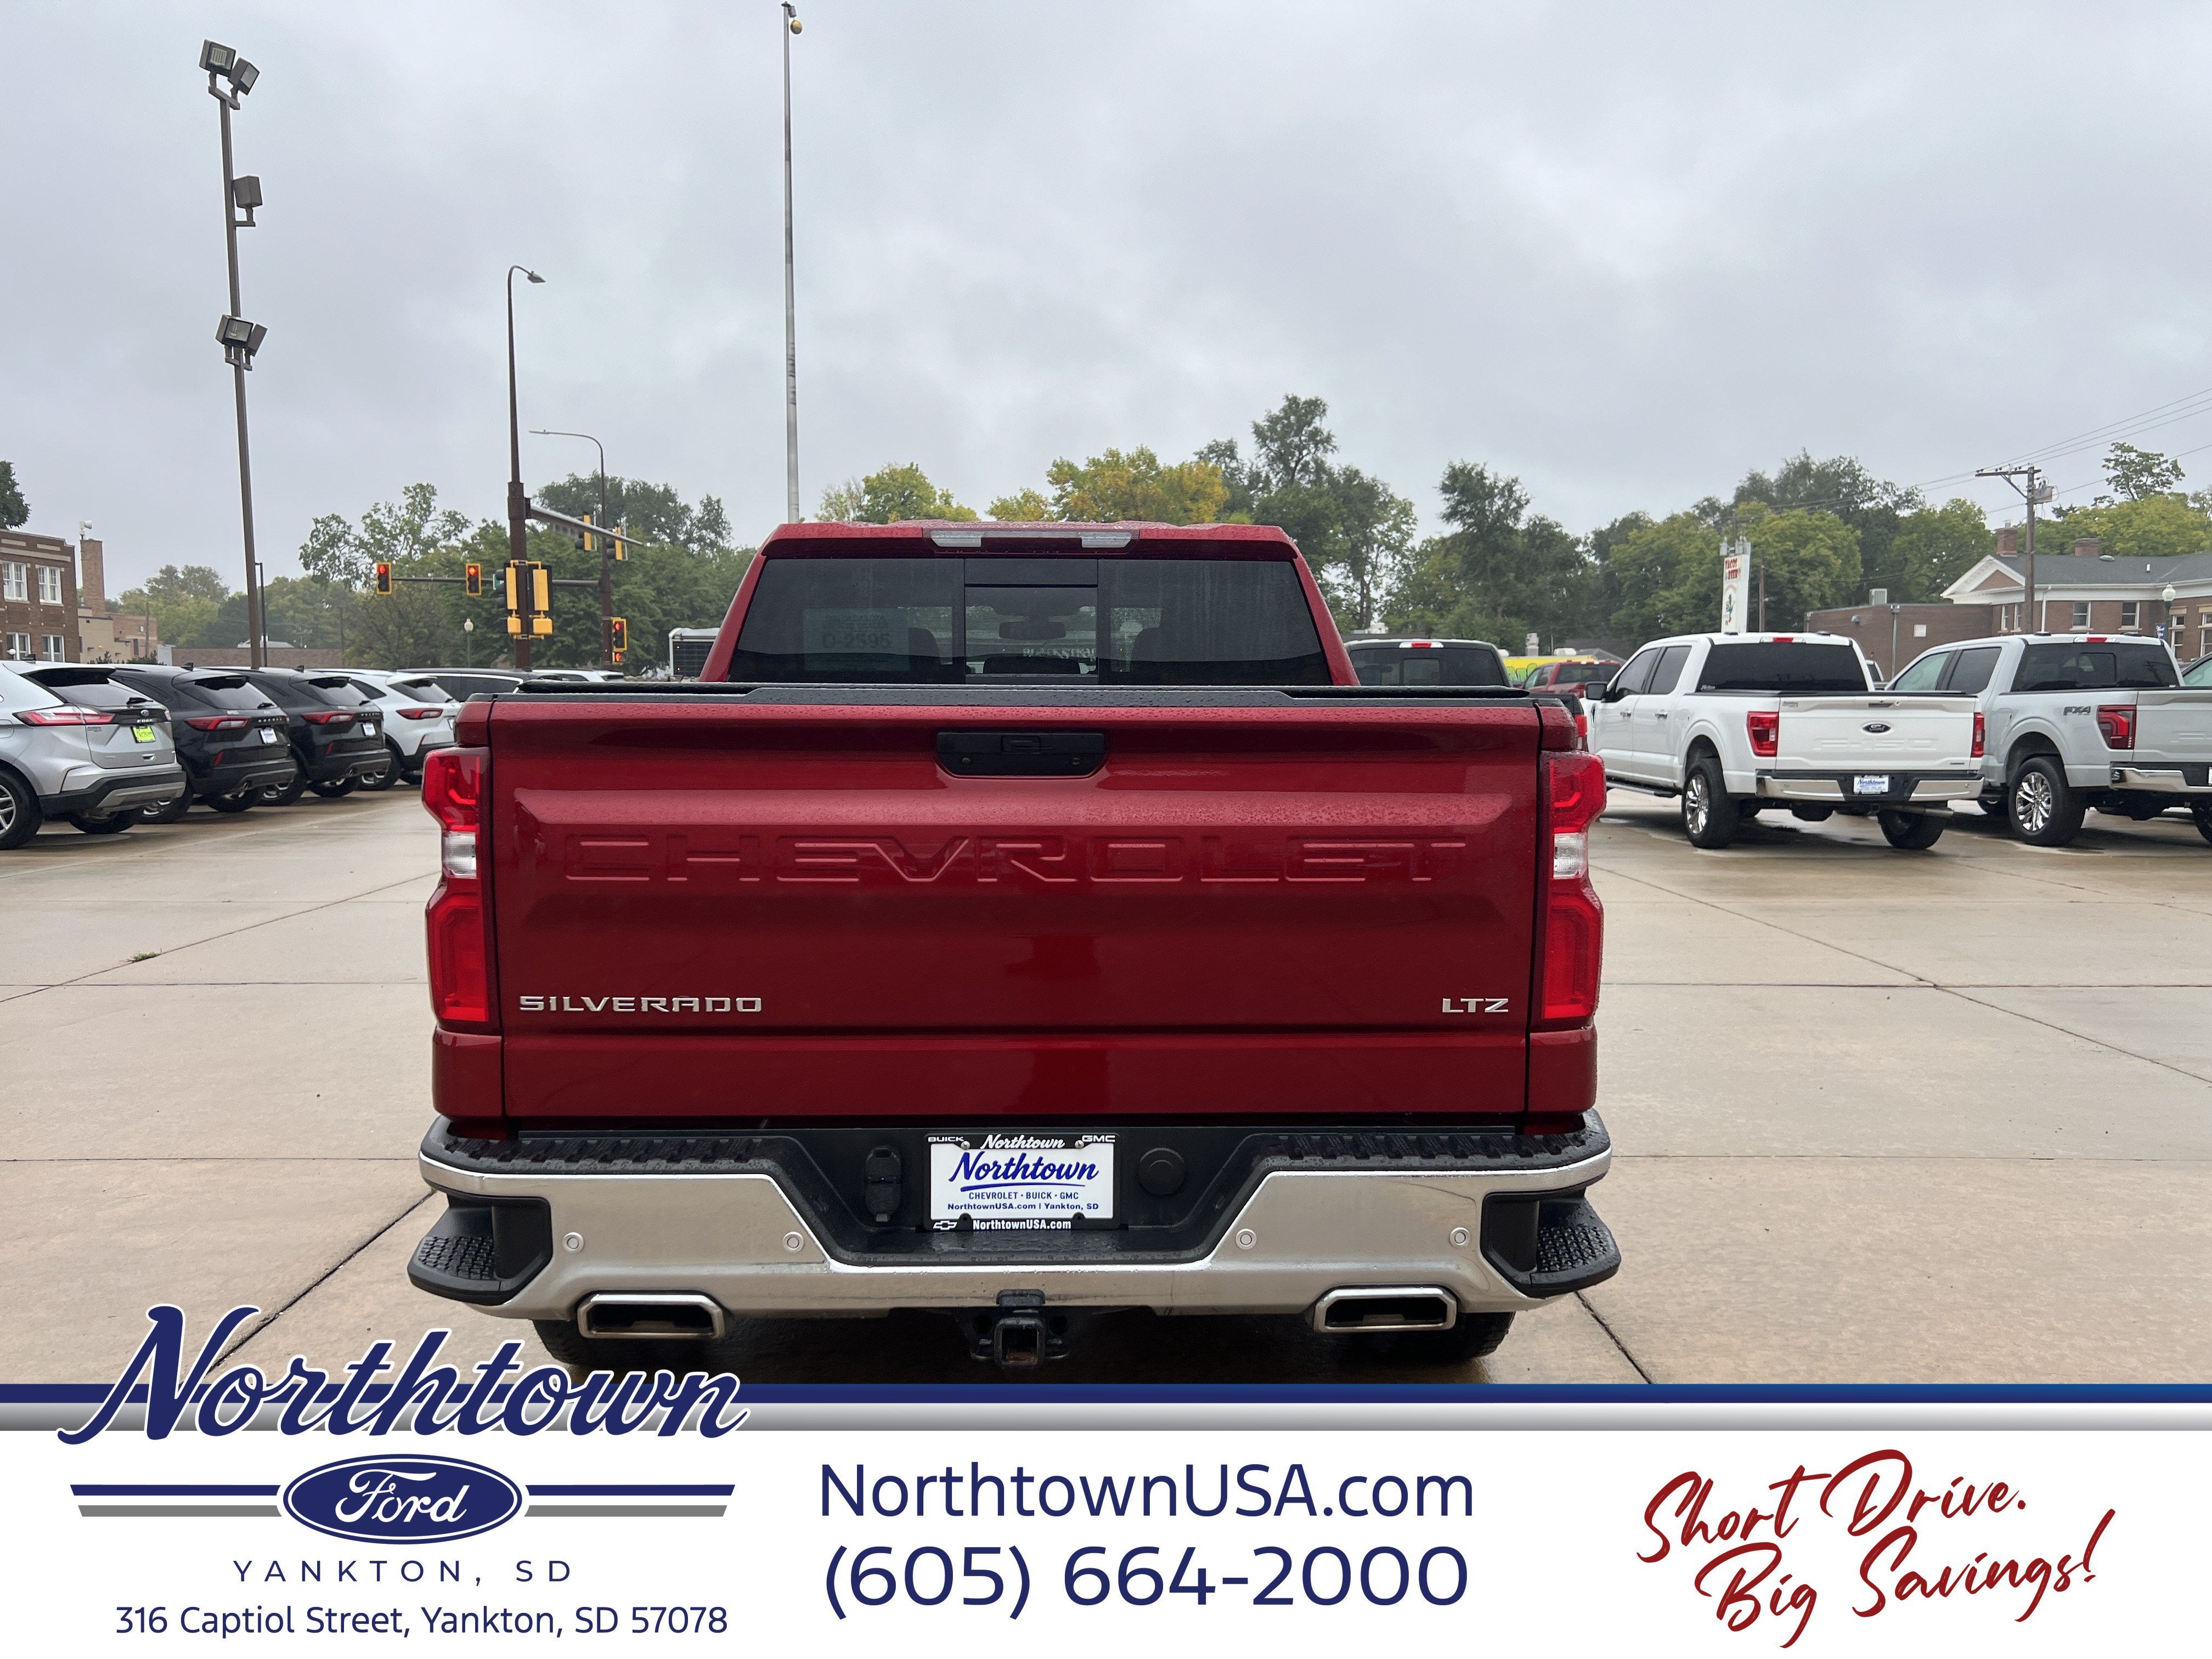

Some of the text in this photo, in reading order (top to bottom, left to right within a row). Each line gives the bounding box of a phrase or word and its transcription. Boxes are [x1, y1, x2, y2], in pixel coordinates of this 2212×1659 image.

[1725, 558, 1737, 569] TACOS
[2063, 706, 2091, 715] FX4
[565, 833, 1466, 882] CHEVROLET
[519, 995, 763, 1013] SILVERADO
[1441, 997, 1509, 1013] LTZ
[980, 1134, 1065, 1149] Northtown
[948, 1150, 1099, 1182] Northtown
[1044, 1203, 1084, 1211] Yankton,
[973, 1219, 1072, 1230] NorthtownUSA.com
